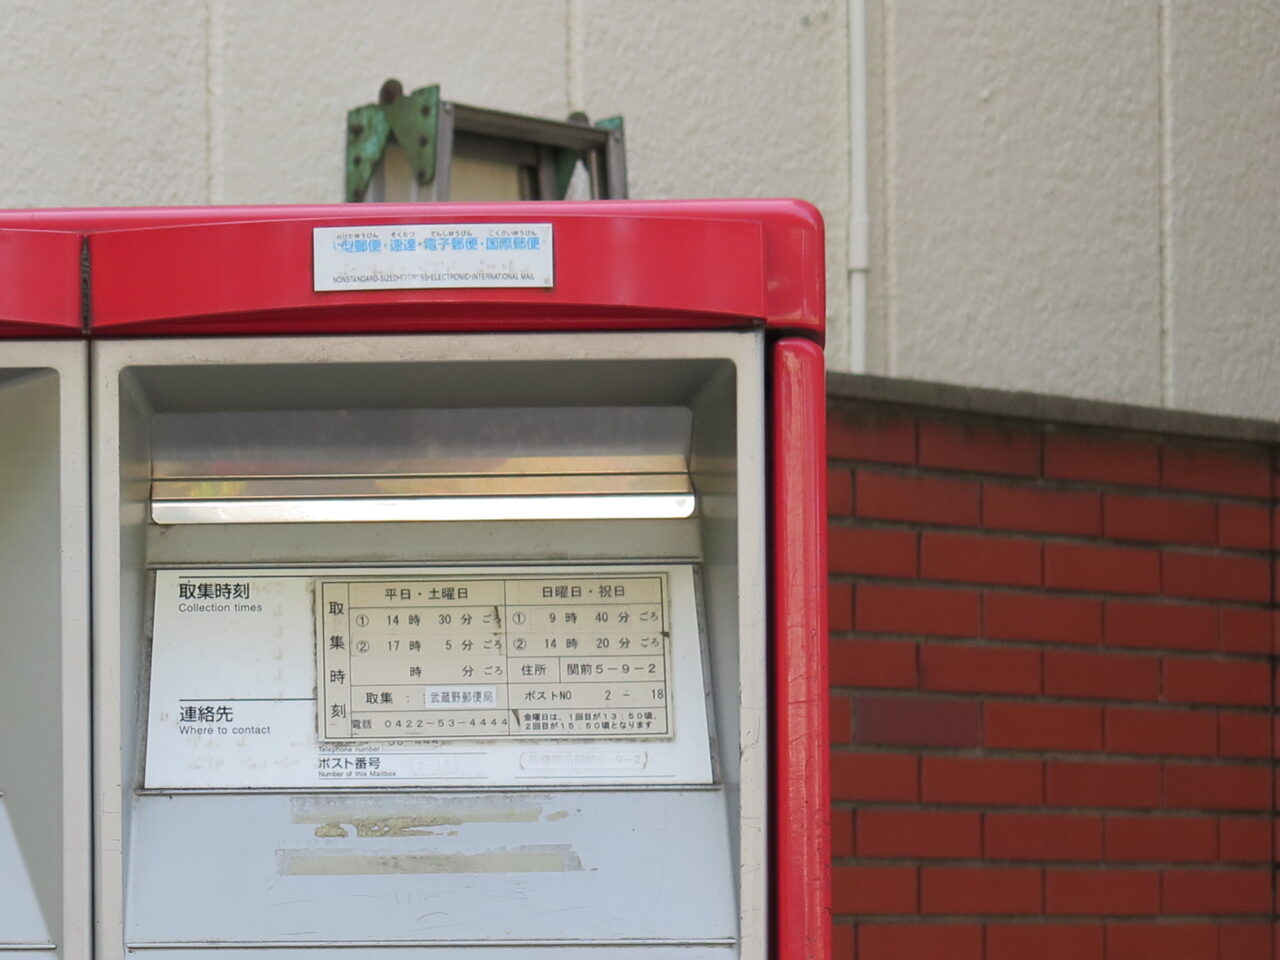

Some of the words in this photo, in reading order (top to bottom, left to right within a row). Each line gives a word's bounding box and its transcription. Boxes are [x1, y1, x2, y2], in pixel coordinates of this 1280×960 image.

[179, 583, 250, 600] 取集時刻
[384, 587, 469, 600] 平日・土曜日
[542, 585, 626, 598] 日曜日・祝日
[178, 602, 231, 613] Collection
[234, 603, 263, 613] times
[386, 614, 400, 625] 14
[438, 614, 452, 625] 30
[549, 612, 556, 623] 9
[595, 611, 609, 623] 40
[387, 640, 400, 652] 17
[445, 639, 452, 651] 5
[544, 638, 557, 649] 14
[596, 637, 610, 649] 20
[521, 664, 547, 676] 住所
[429, 690, 494, 704] 武蔵野郵便局
[179, 706, 234, 723] 連絡先
[179, 726, 214, 735] Where
[217, 726, 228, 735] to
[232, 726, 271, 735] contact
[351, 719, 373, 730] 電話
[319, 757, 381, 769] ポスト番号
